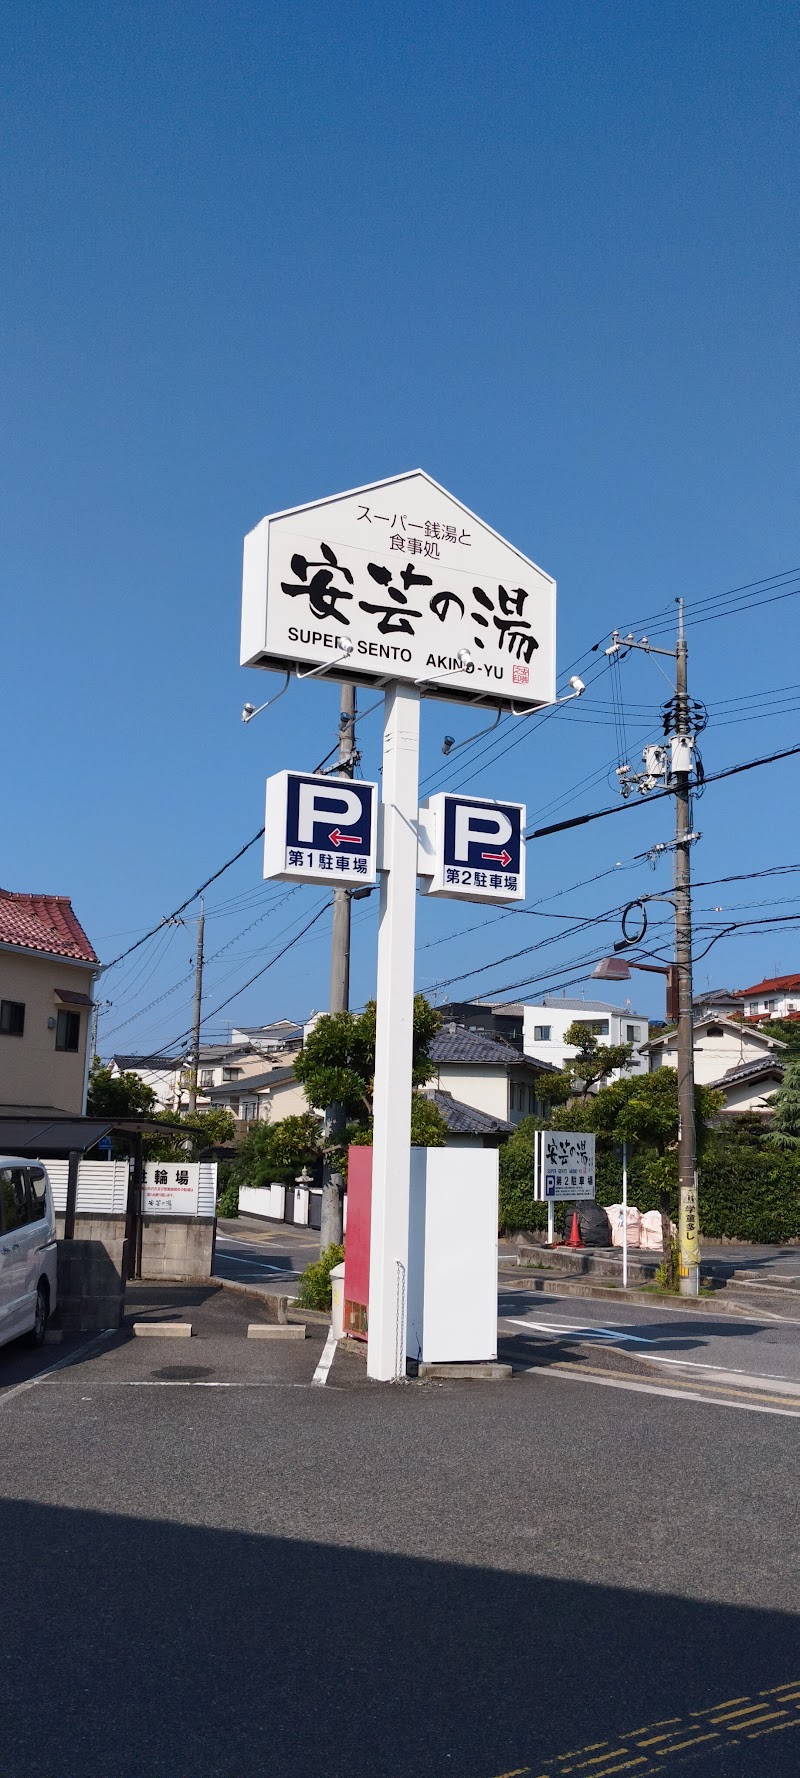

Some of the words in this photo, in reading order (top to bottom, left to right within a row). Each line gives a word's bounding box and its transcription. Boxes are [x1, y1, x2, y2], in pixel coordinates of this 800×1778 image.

[357, 505, 472, 547] スーパー銭湯と
[389, 534, 440, 560] 食事処
[281, 542, 539, 664] 安芸の湯
[357, 640, 412, 662] SENTO
[426, 653, 503, 680] AKINO-YU
[298, 782, 363, 843] P
[454, 805, 513, 862] P
[288, 849, 368, 875] 第1駐車場
[446, 868, 518, 892] 第2駐車場
[546, 1138, 588, 1166] 安芸の湯
[546, 1176, 555, 1195] P
[556, 1176, 593, 1186] 第2駐車場
